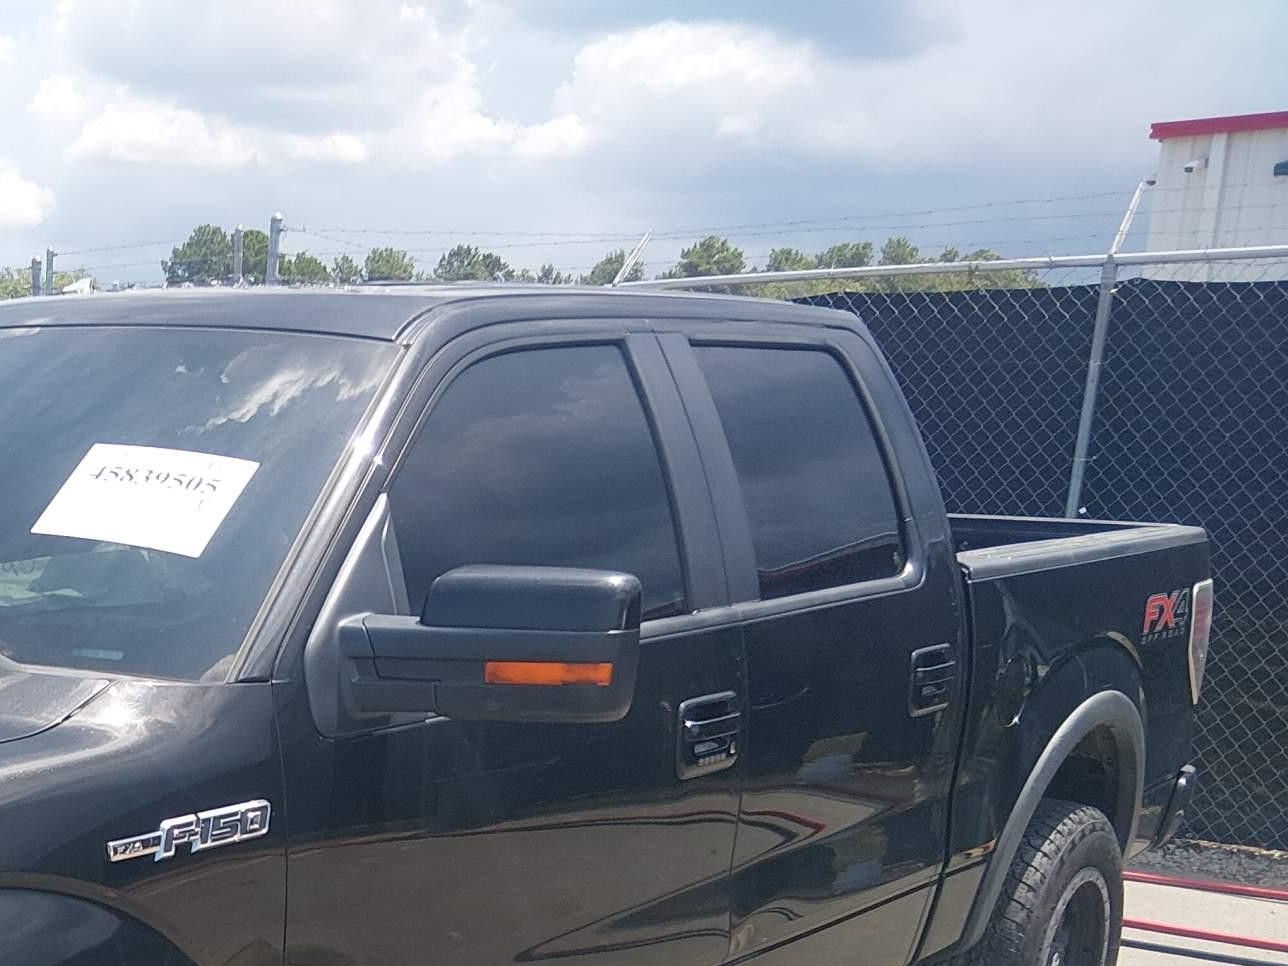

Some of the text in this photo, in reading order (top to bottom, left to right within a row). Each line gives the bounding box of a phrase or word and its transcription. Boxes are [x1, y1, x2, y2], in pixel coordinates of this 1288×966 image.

[90, 465, 221, 493] 45839505
[1143, 587, 1190, 634] FX4
[155, 799, 271, 862] F-150
